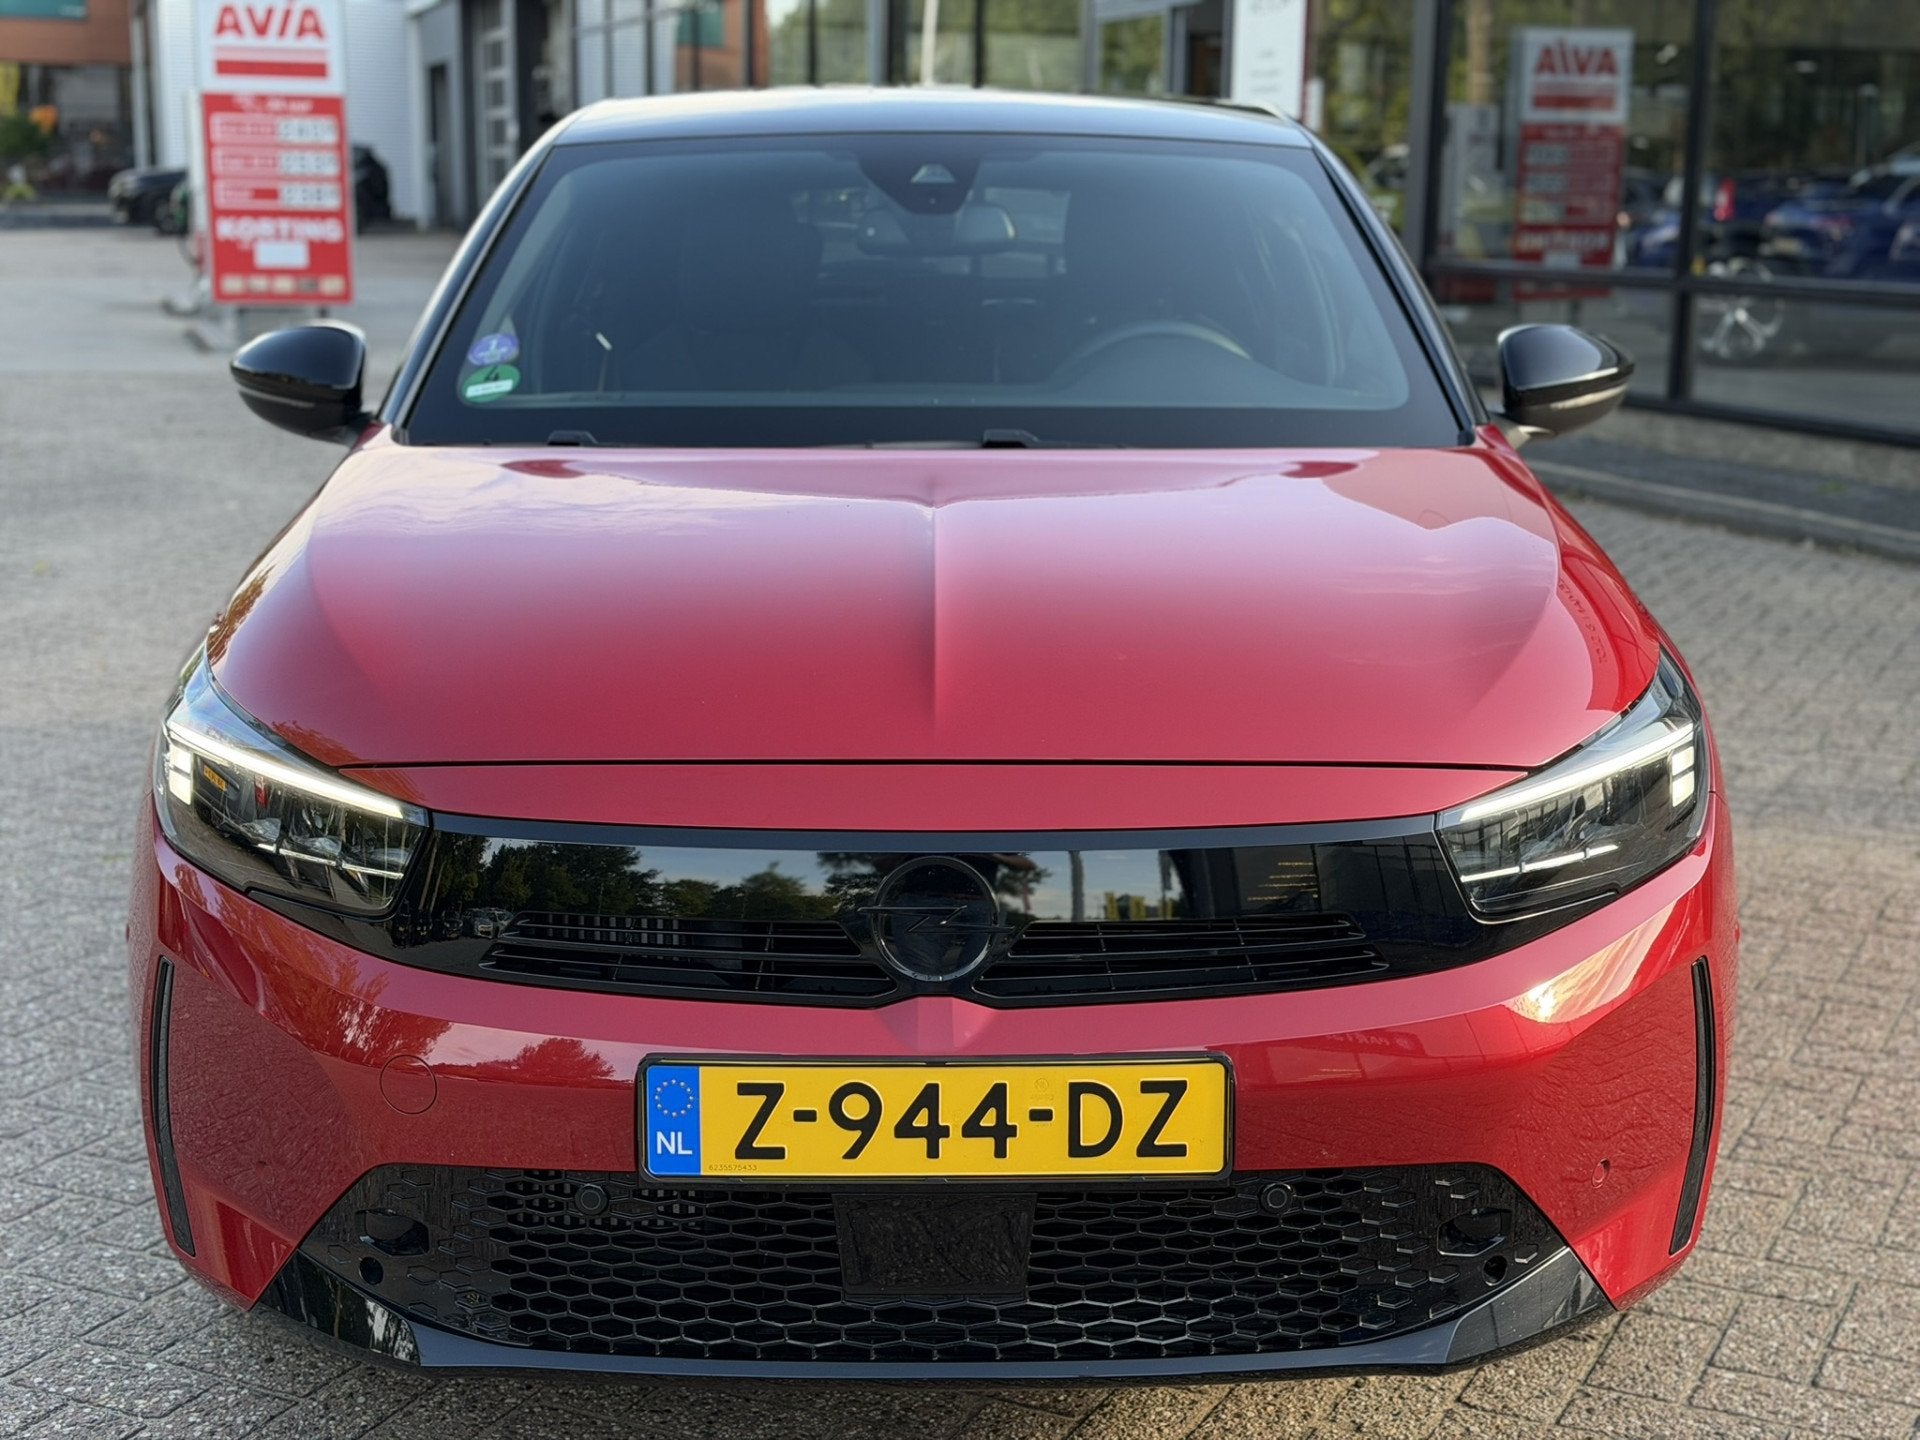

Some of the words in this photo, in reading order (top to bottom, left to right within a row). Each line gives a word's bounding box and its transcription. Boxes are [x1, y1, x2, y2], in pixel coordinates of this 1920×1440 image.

[215, 2, 325, 39] AVIA
[734, 1080, 1188, 1160] Z-944-DZ
[656, 1131, 693, 1155] NL
